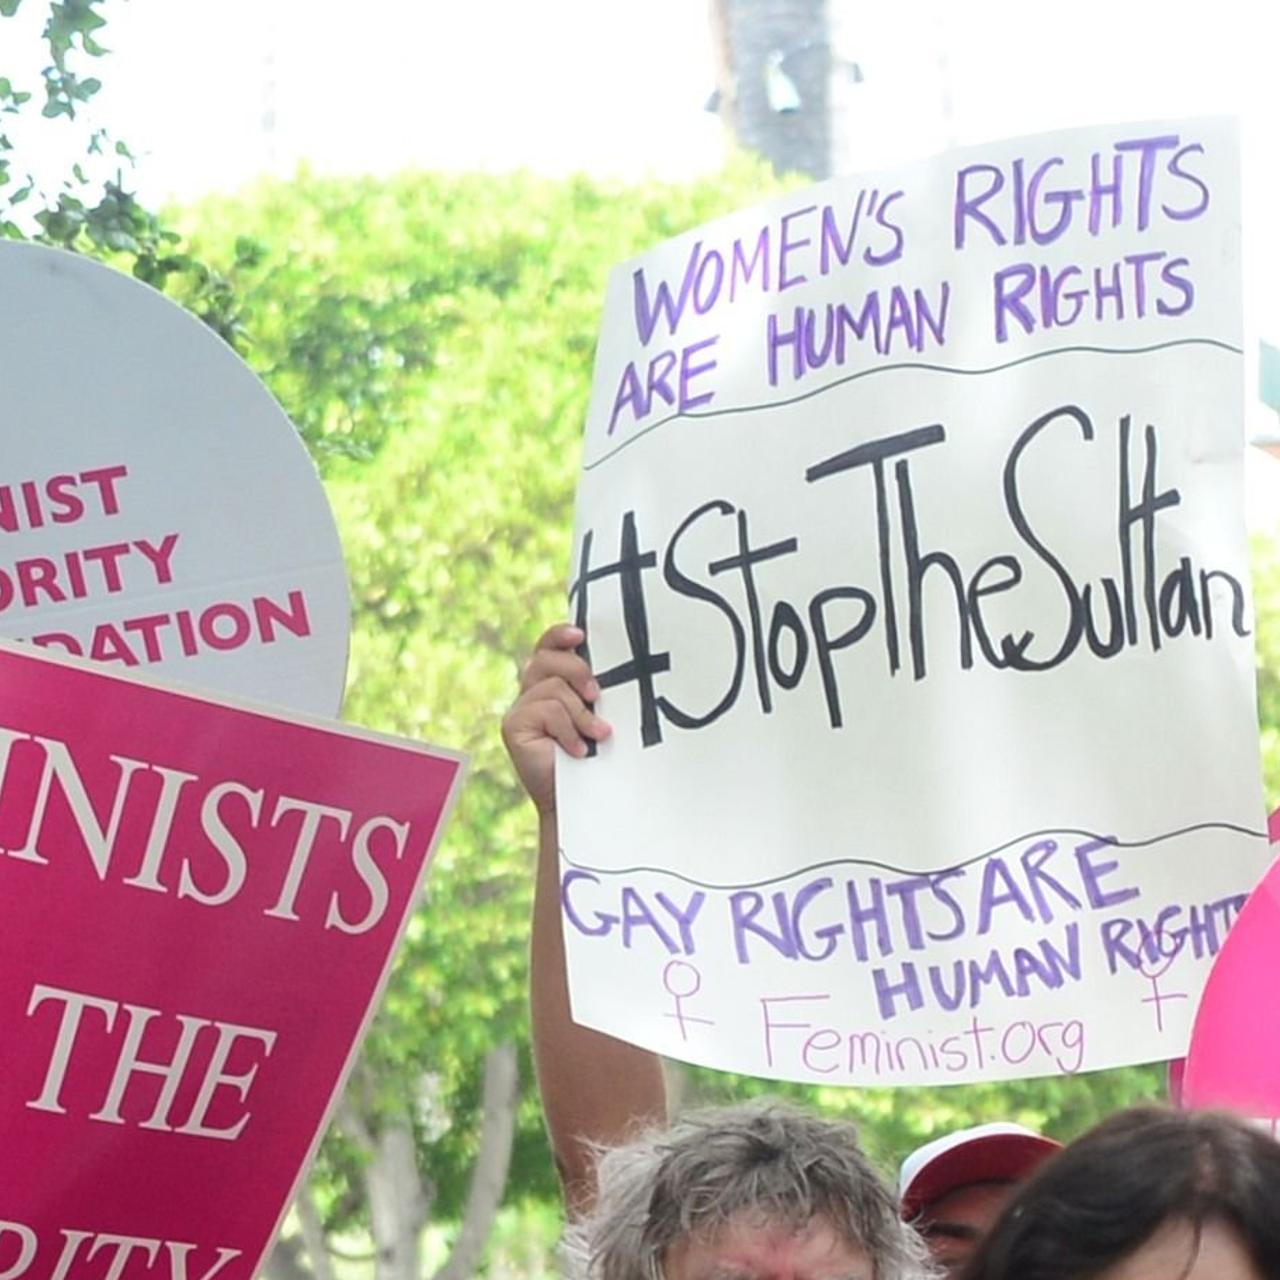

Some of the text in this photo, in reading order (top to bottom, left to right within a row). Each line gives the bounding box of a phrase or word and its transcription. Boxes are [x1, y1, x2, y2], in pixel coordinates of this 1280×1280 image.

[633, 134, 1210, 346] WOMEN'S RIGHTS
[608, 252, 1194, 436] ARE HUMAN RIGHTS
[562, 869, 705, 955] GAY
[872, 893, 1250, 1020] HUMAN RIGHT
[25, 984, 276, 1142] THE
